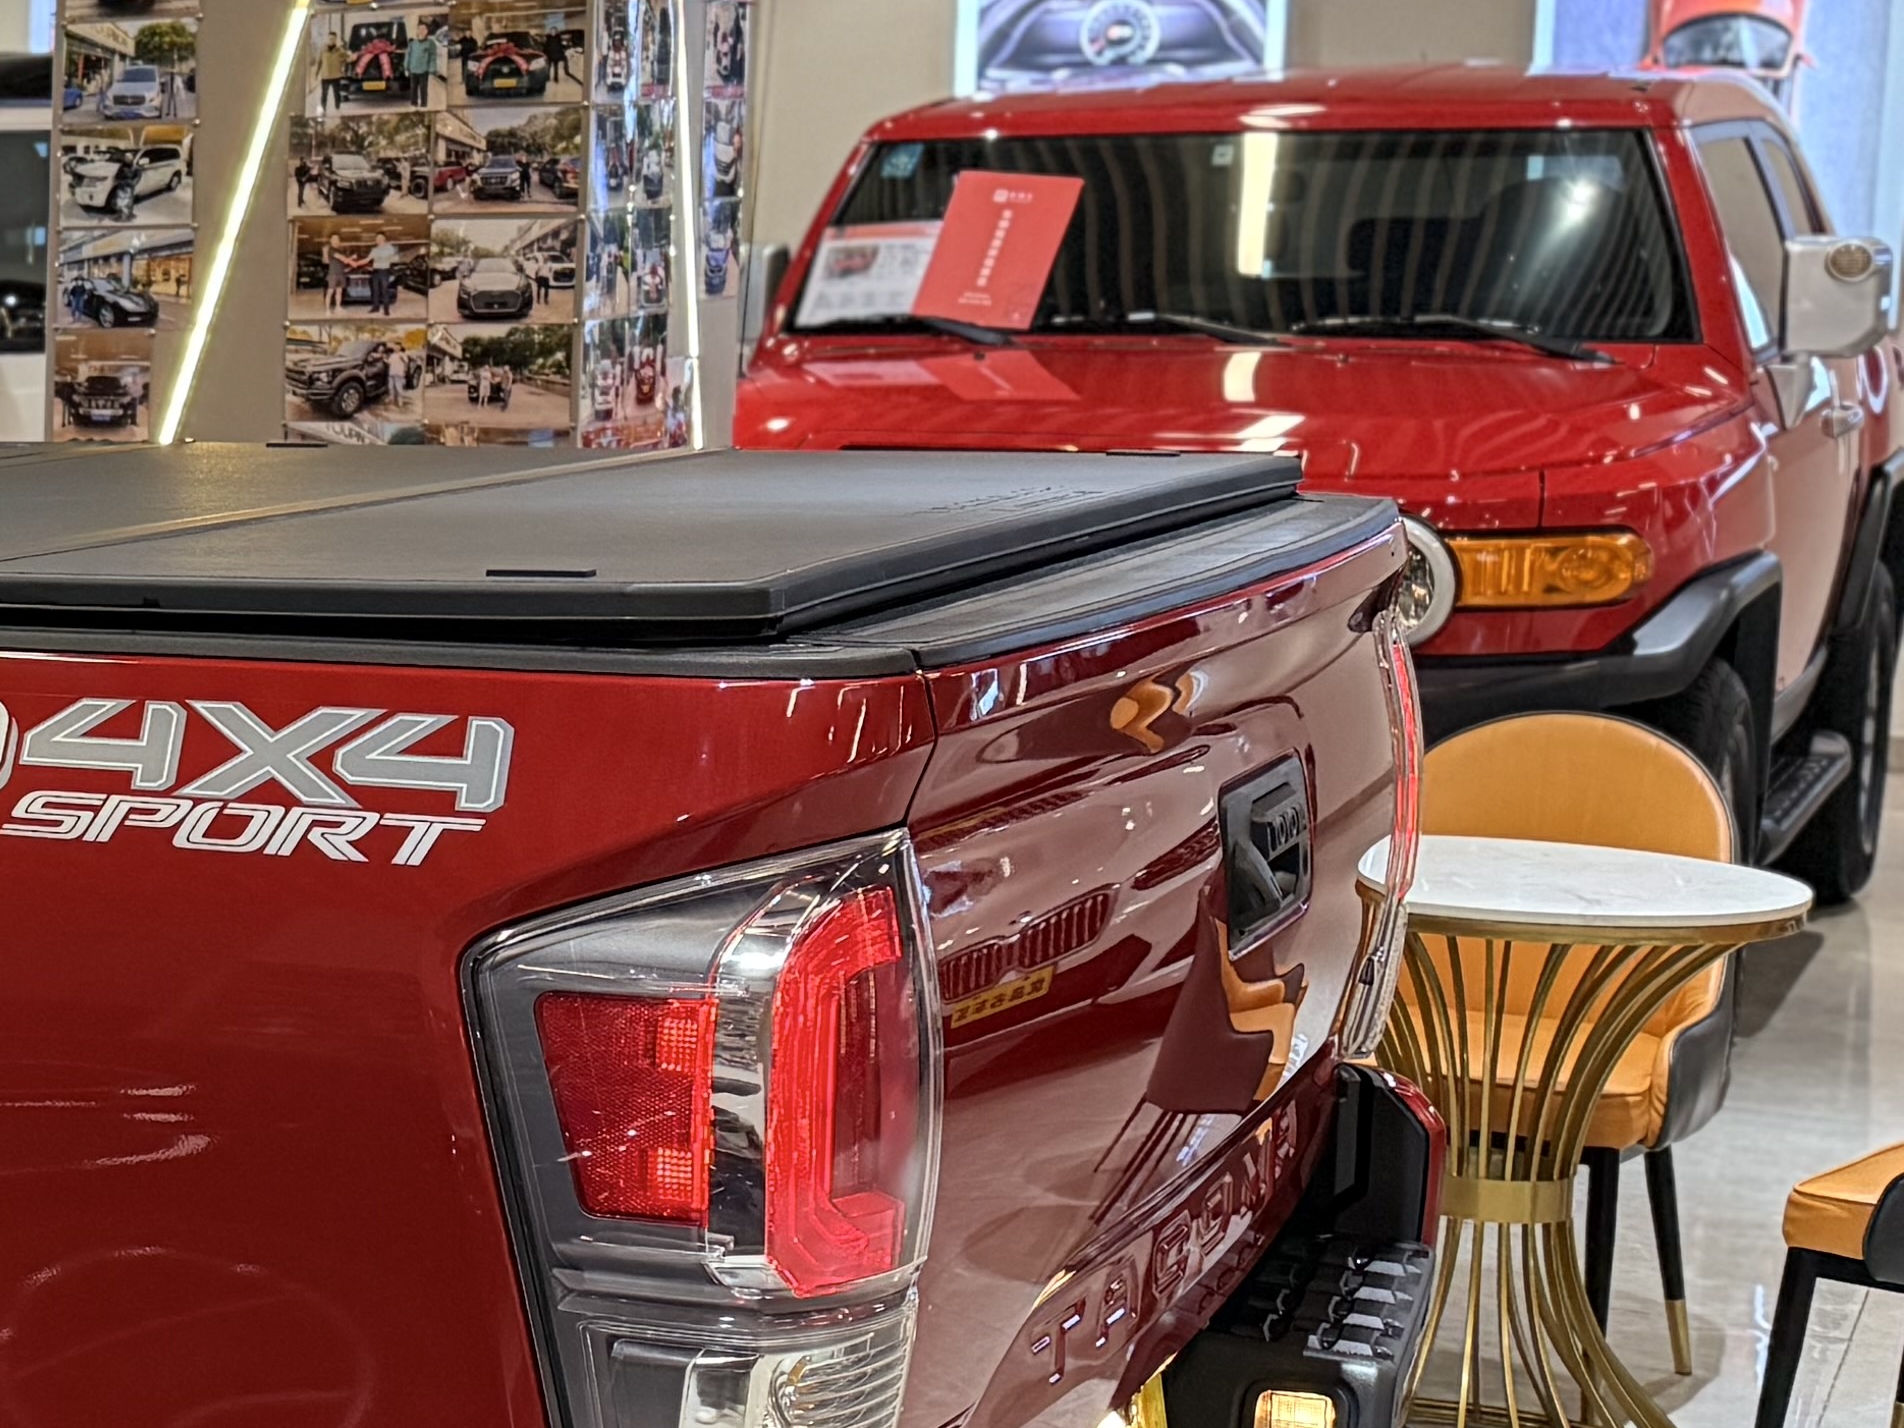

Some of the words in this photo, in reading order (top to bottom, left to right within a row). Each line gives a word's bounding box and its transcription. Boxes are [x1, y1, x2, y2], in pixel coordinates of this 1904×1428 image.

[21, 697, 514, 813] 4X4
[0, 790, 486, 867] SPORT
[1032, 1100, 1297, 1384] TACOMA
